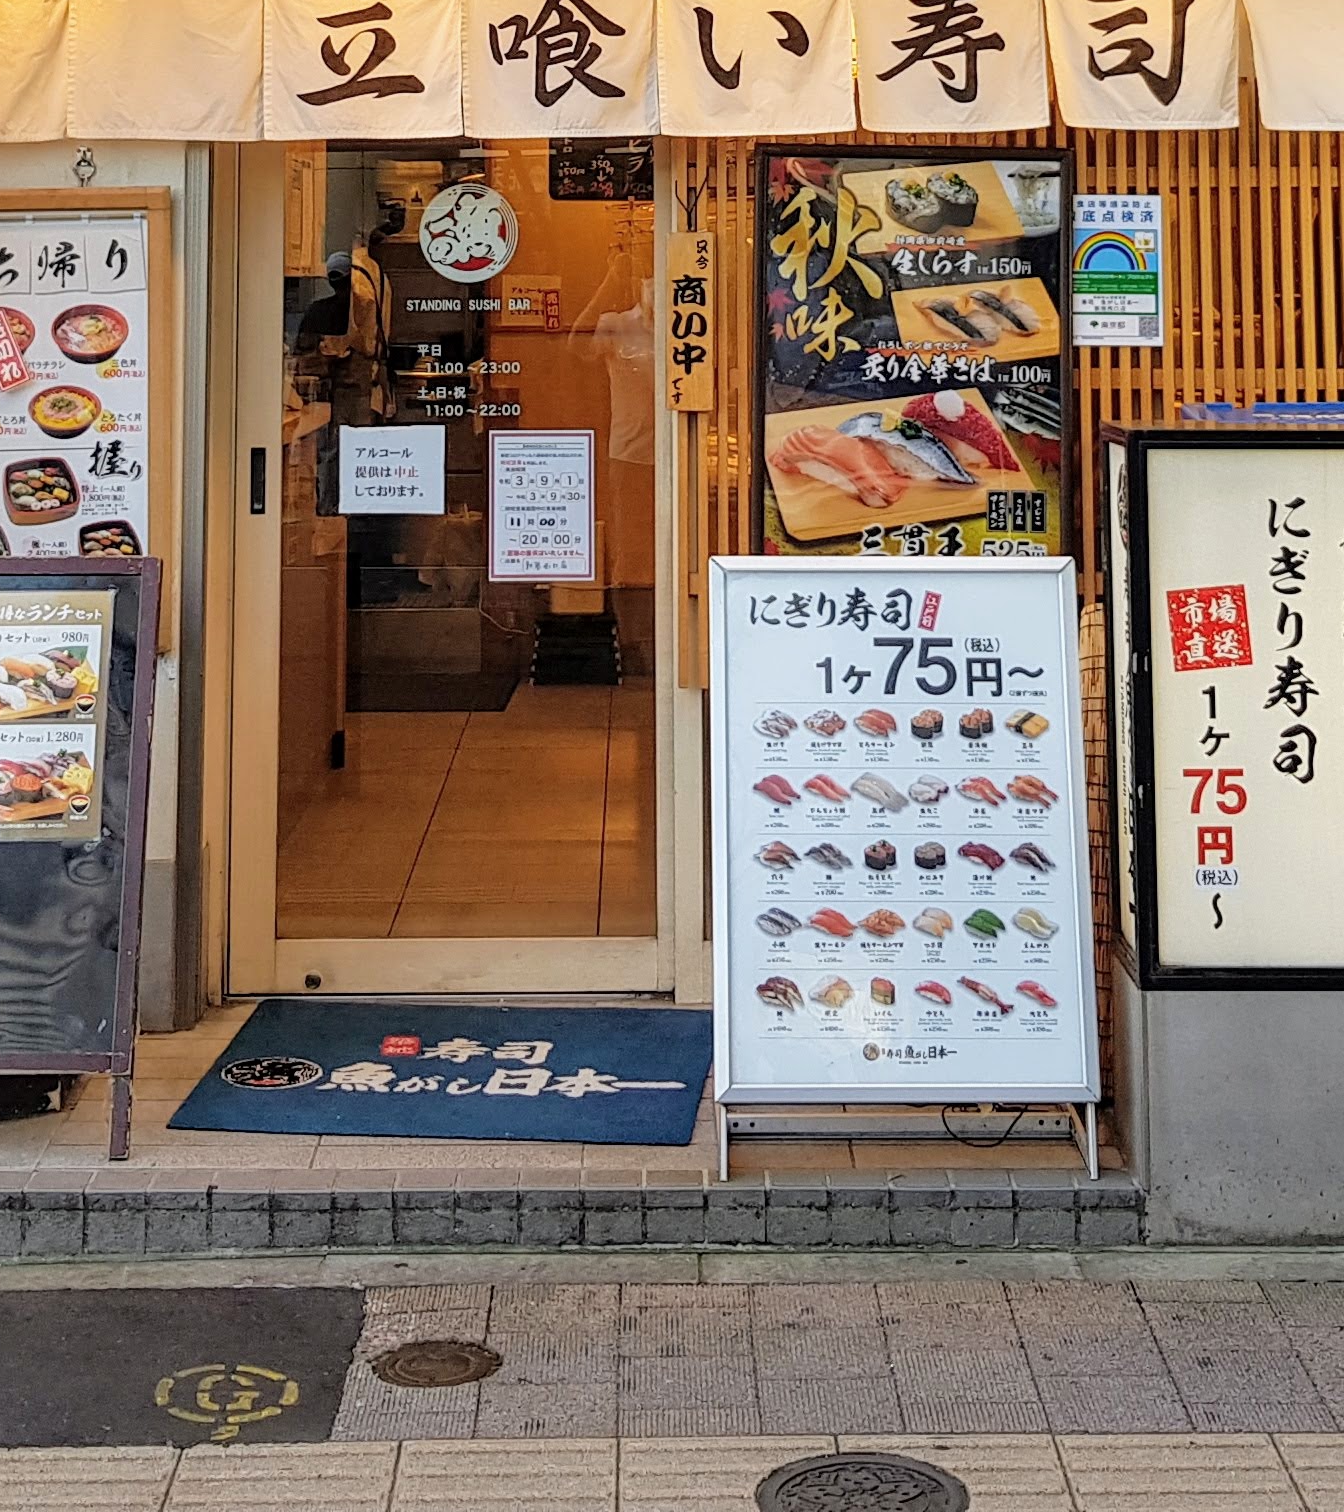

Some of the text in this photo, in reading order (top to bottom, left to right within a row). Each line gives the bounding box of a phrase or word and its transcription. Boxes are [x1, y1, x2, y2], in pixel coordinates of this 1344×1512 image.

[891, 249, 978, 276] 生しらす
[406, 299, 531, 312] STANDING SUSHI BAR
[671, 274, 708, 375] 商い中
[417, 344, 442, 357] 平日
[111, 359, 137, 368] 三色丼
[425, 361, 521, 376] 11:00～23:00
[860, 353, 996, 387] 炙り金華さば
[102, 413, 142, 422] とろたく丼
[425, 404, 521, 418] 11:00～22:00
[88, 439, 144, 482] 握り
[355, 447, 413, 460] アルコール
[355, 466, 420, 480] 提供は中止
[355, 485, 425, 499] しております。
[750, 588, 913, 631] にぎり寿司
[1179, 594, 1239, 626] 市場
[61, 631, 89, 643] 980円
[1262, 496, 1320, 784] にぎり寿司
[965, 638, 1001, 654] (税込)
[1183, 629, 1242, 663] 直送
[420, 1037, 553, 1064] 寿司
[317, 1061, 687, 1098] 魚がし日本一
